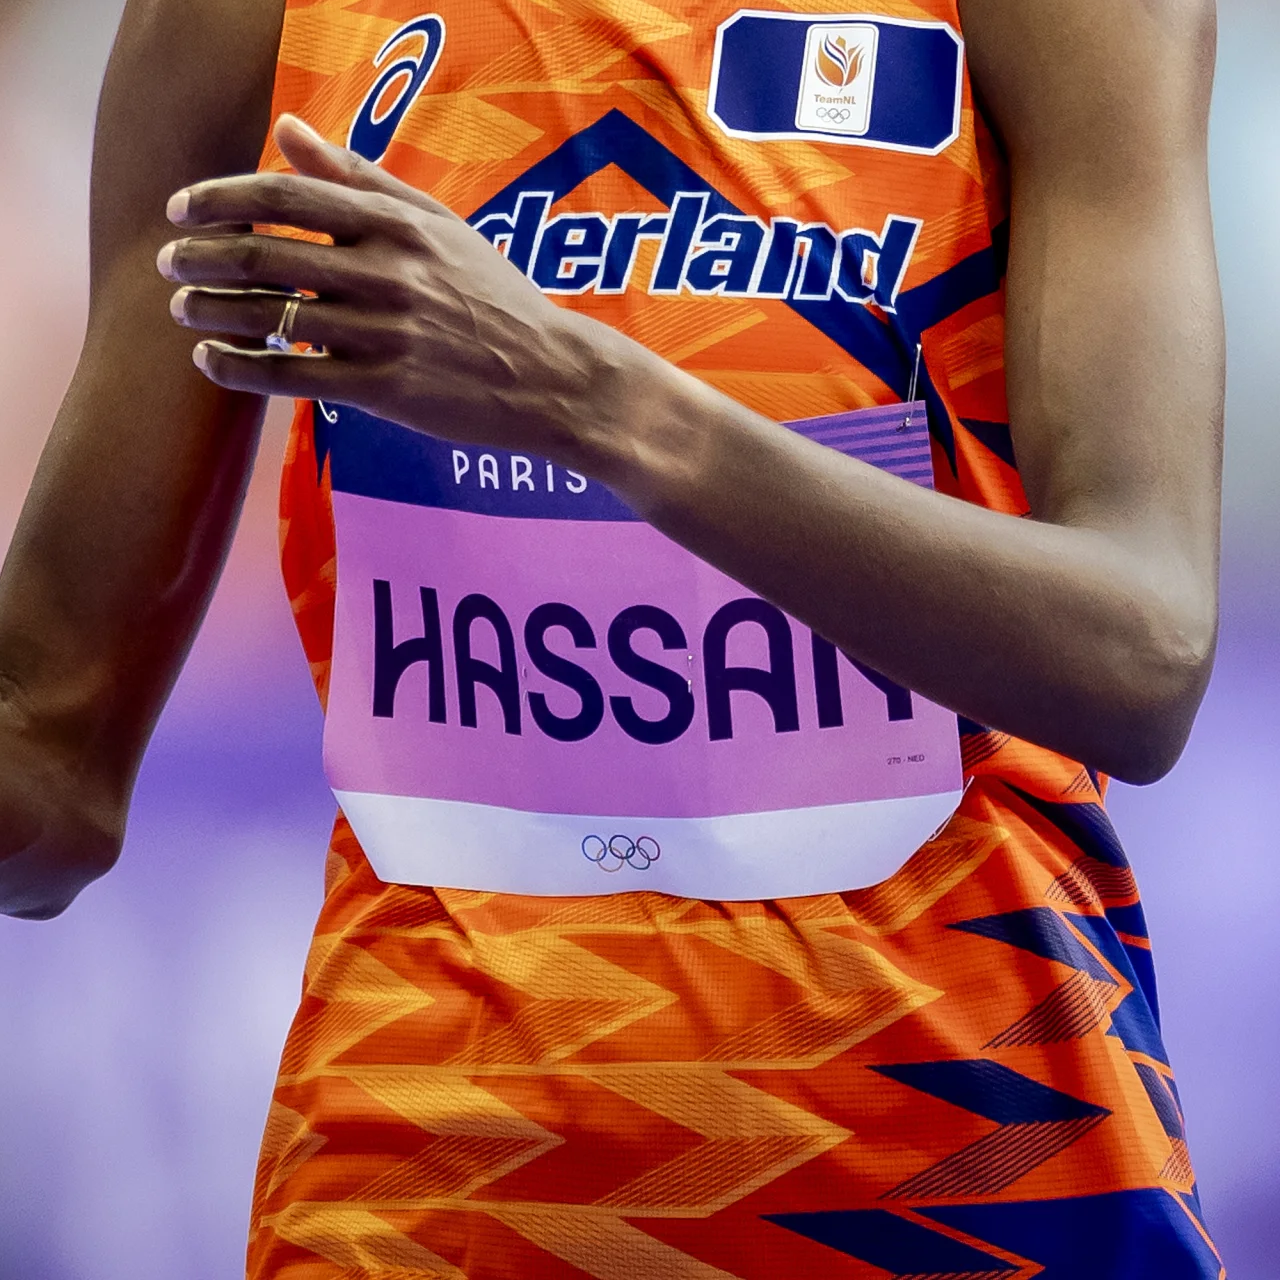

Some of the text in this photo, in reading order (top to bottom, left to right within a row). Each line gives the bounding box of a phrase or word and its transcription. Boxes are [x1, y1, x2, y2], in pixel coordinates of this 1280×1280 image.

[814, 94, 857, 105] TeamNL
[472, 191, 924, 315] derland
[452, 449, 588, 494] PARIS
